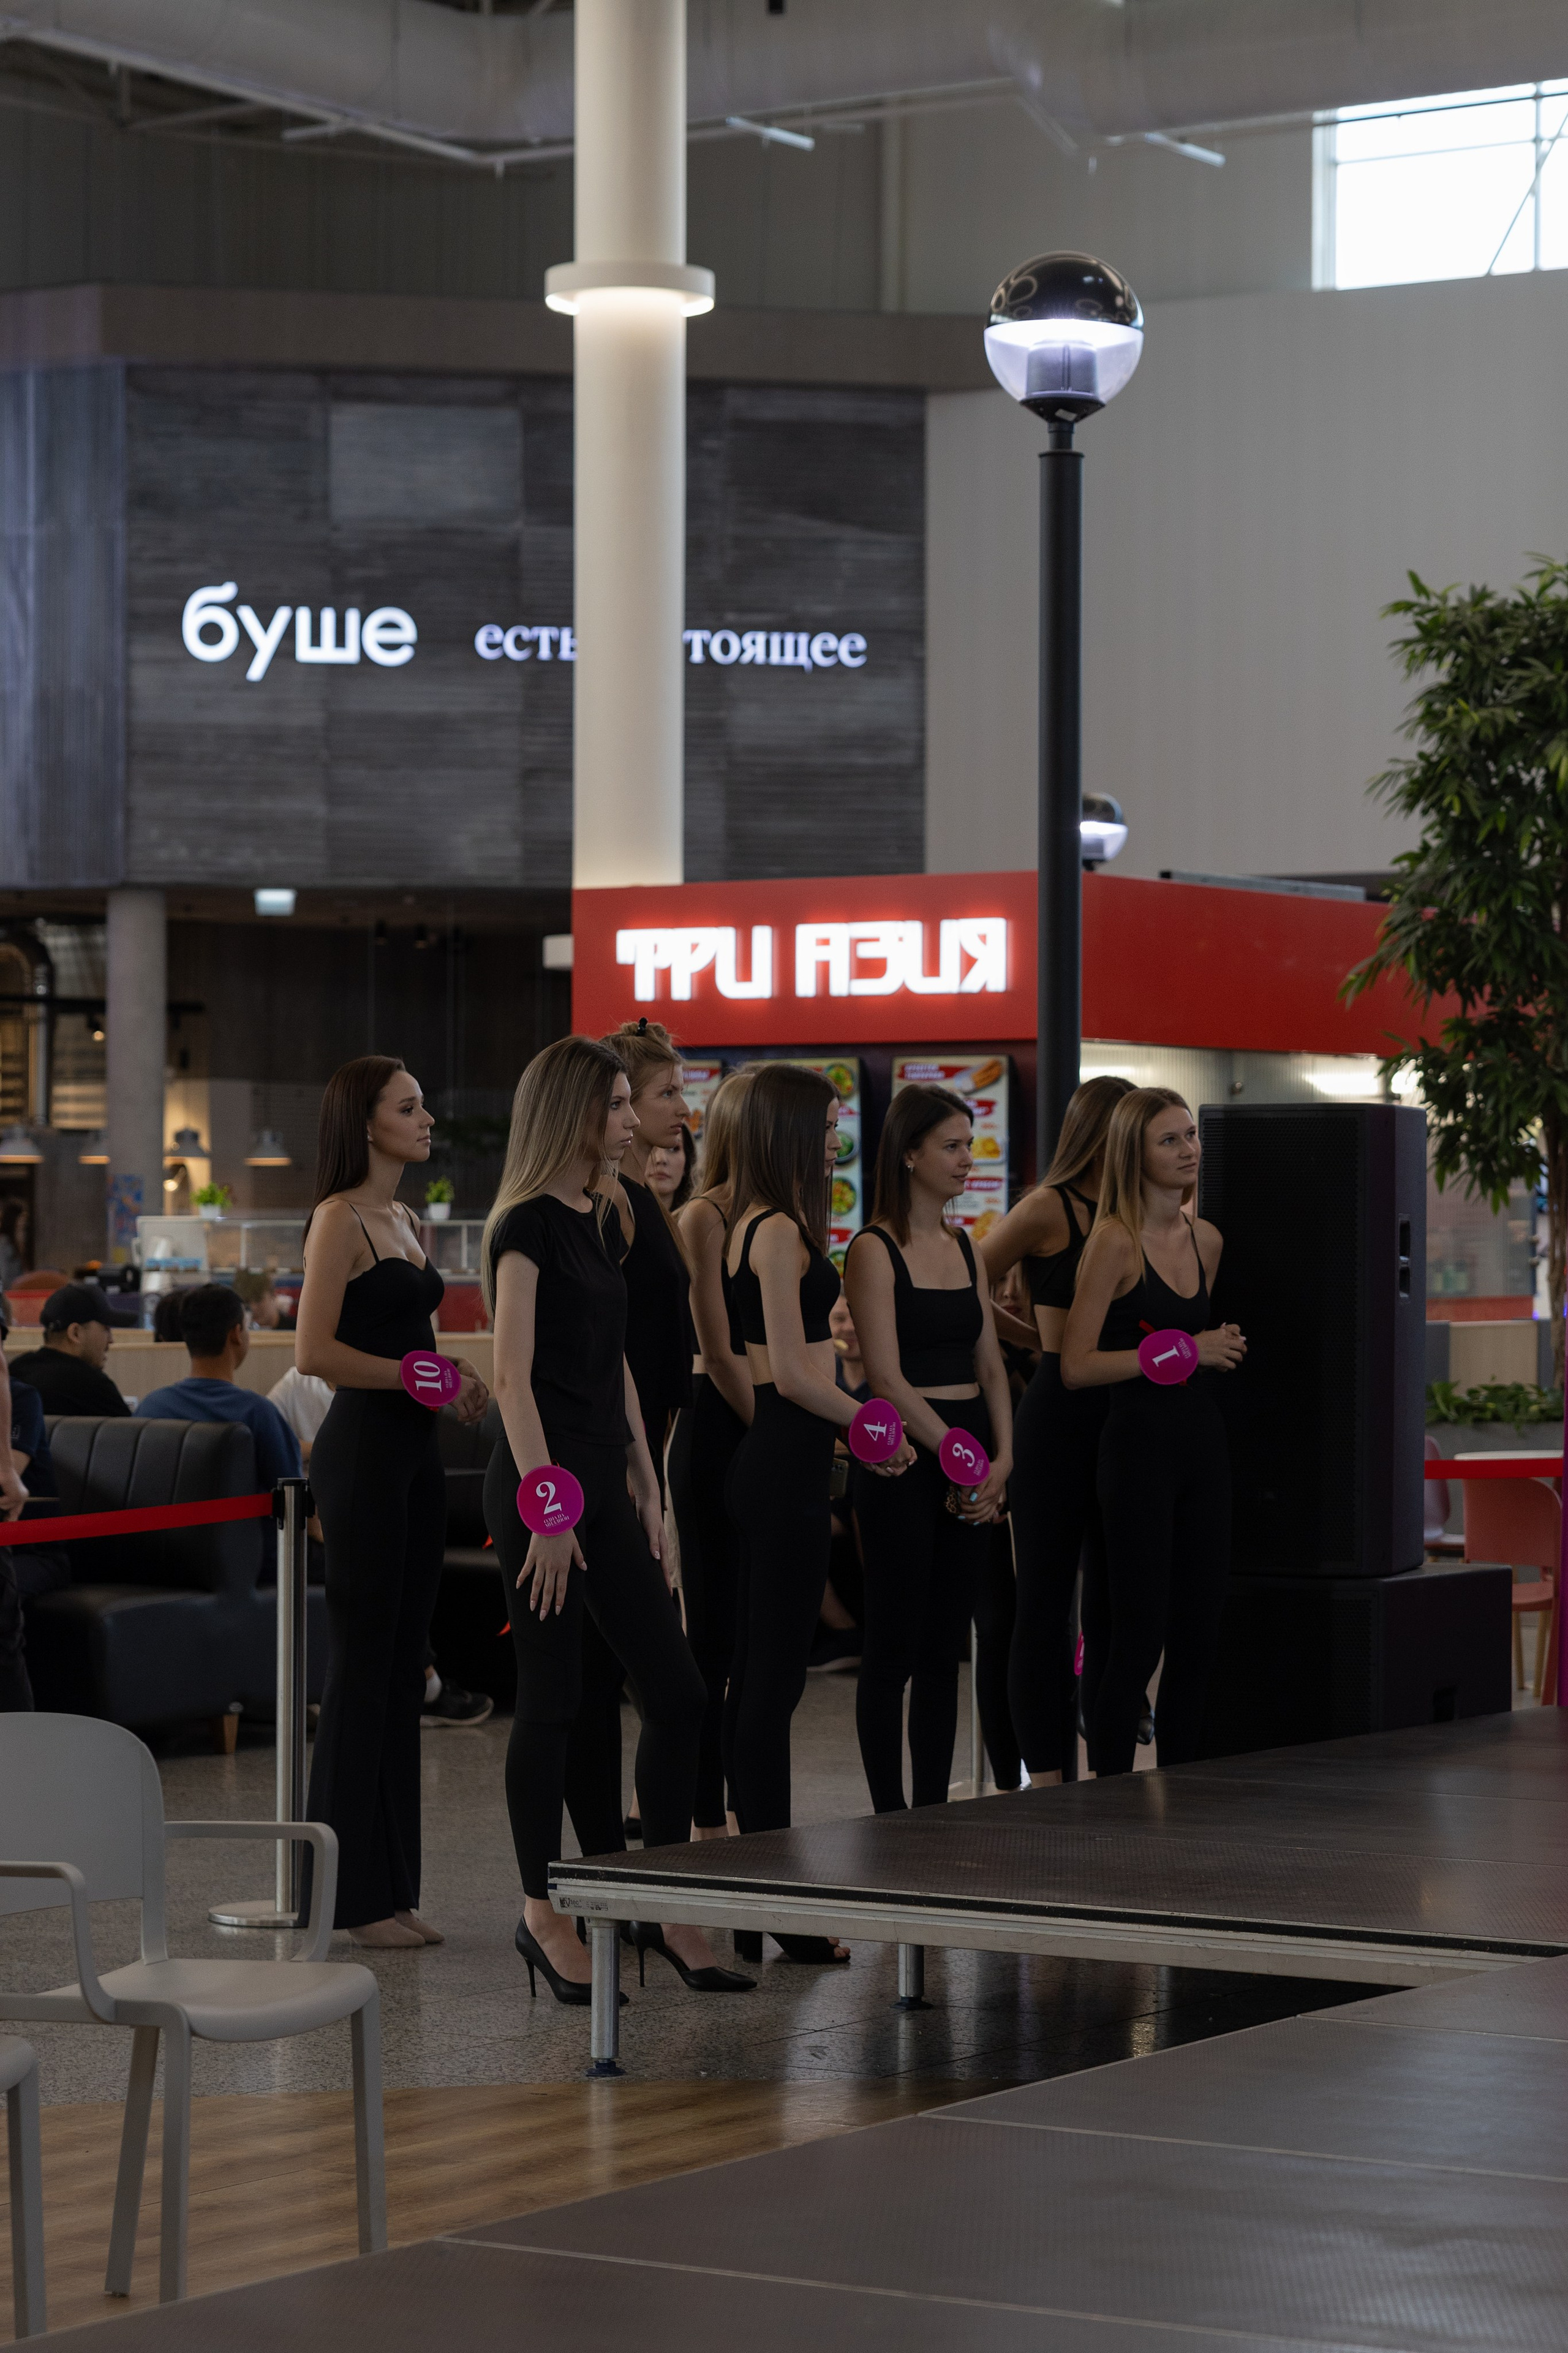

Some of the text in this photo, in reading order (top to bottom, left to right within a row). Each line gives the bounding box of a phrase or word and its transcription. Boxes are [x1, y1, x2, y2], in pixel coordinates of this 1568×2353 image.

[182, 581, 418, 682] буше
[474, 624, 867, 672] есть тоящее
[1152, 1345, 1180, 1367] 1
[413, 1361, 442, 1392] 10
[864, 1421, 886, 1441] 4
[952, 1443, 975, 1467] 3
[536, 1481, 562, 1515] 2
